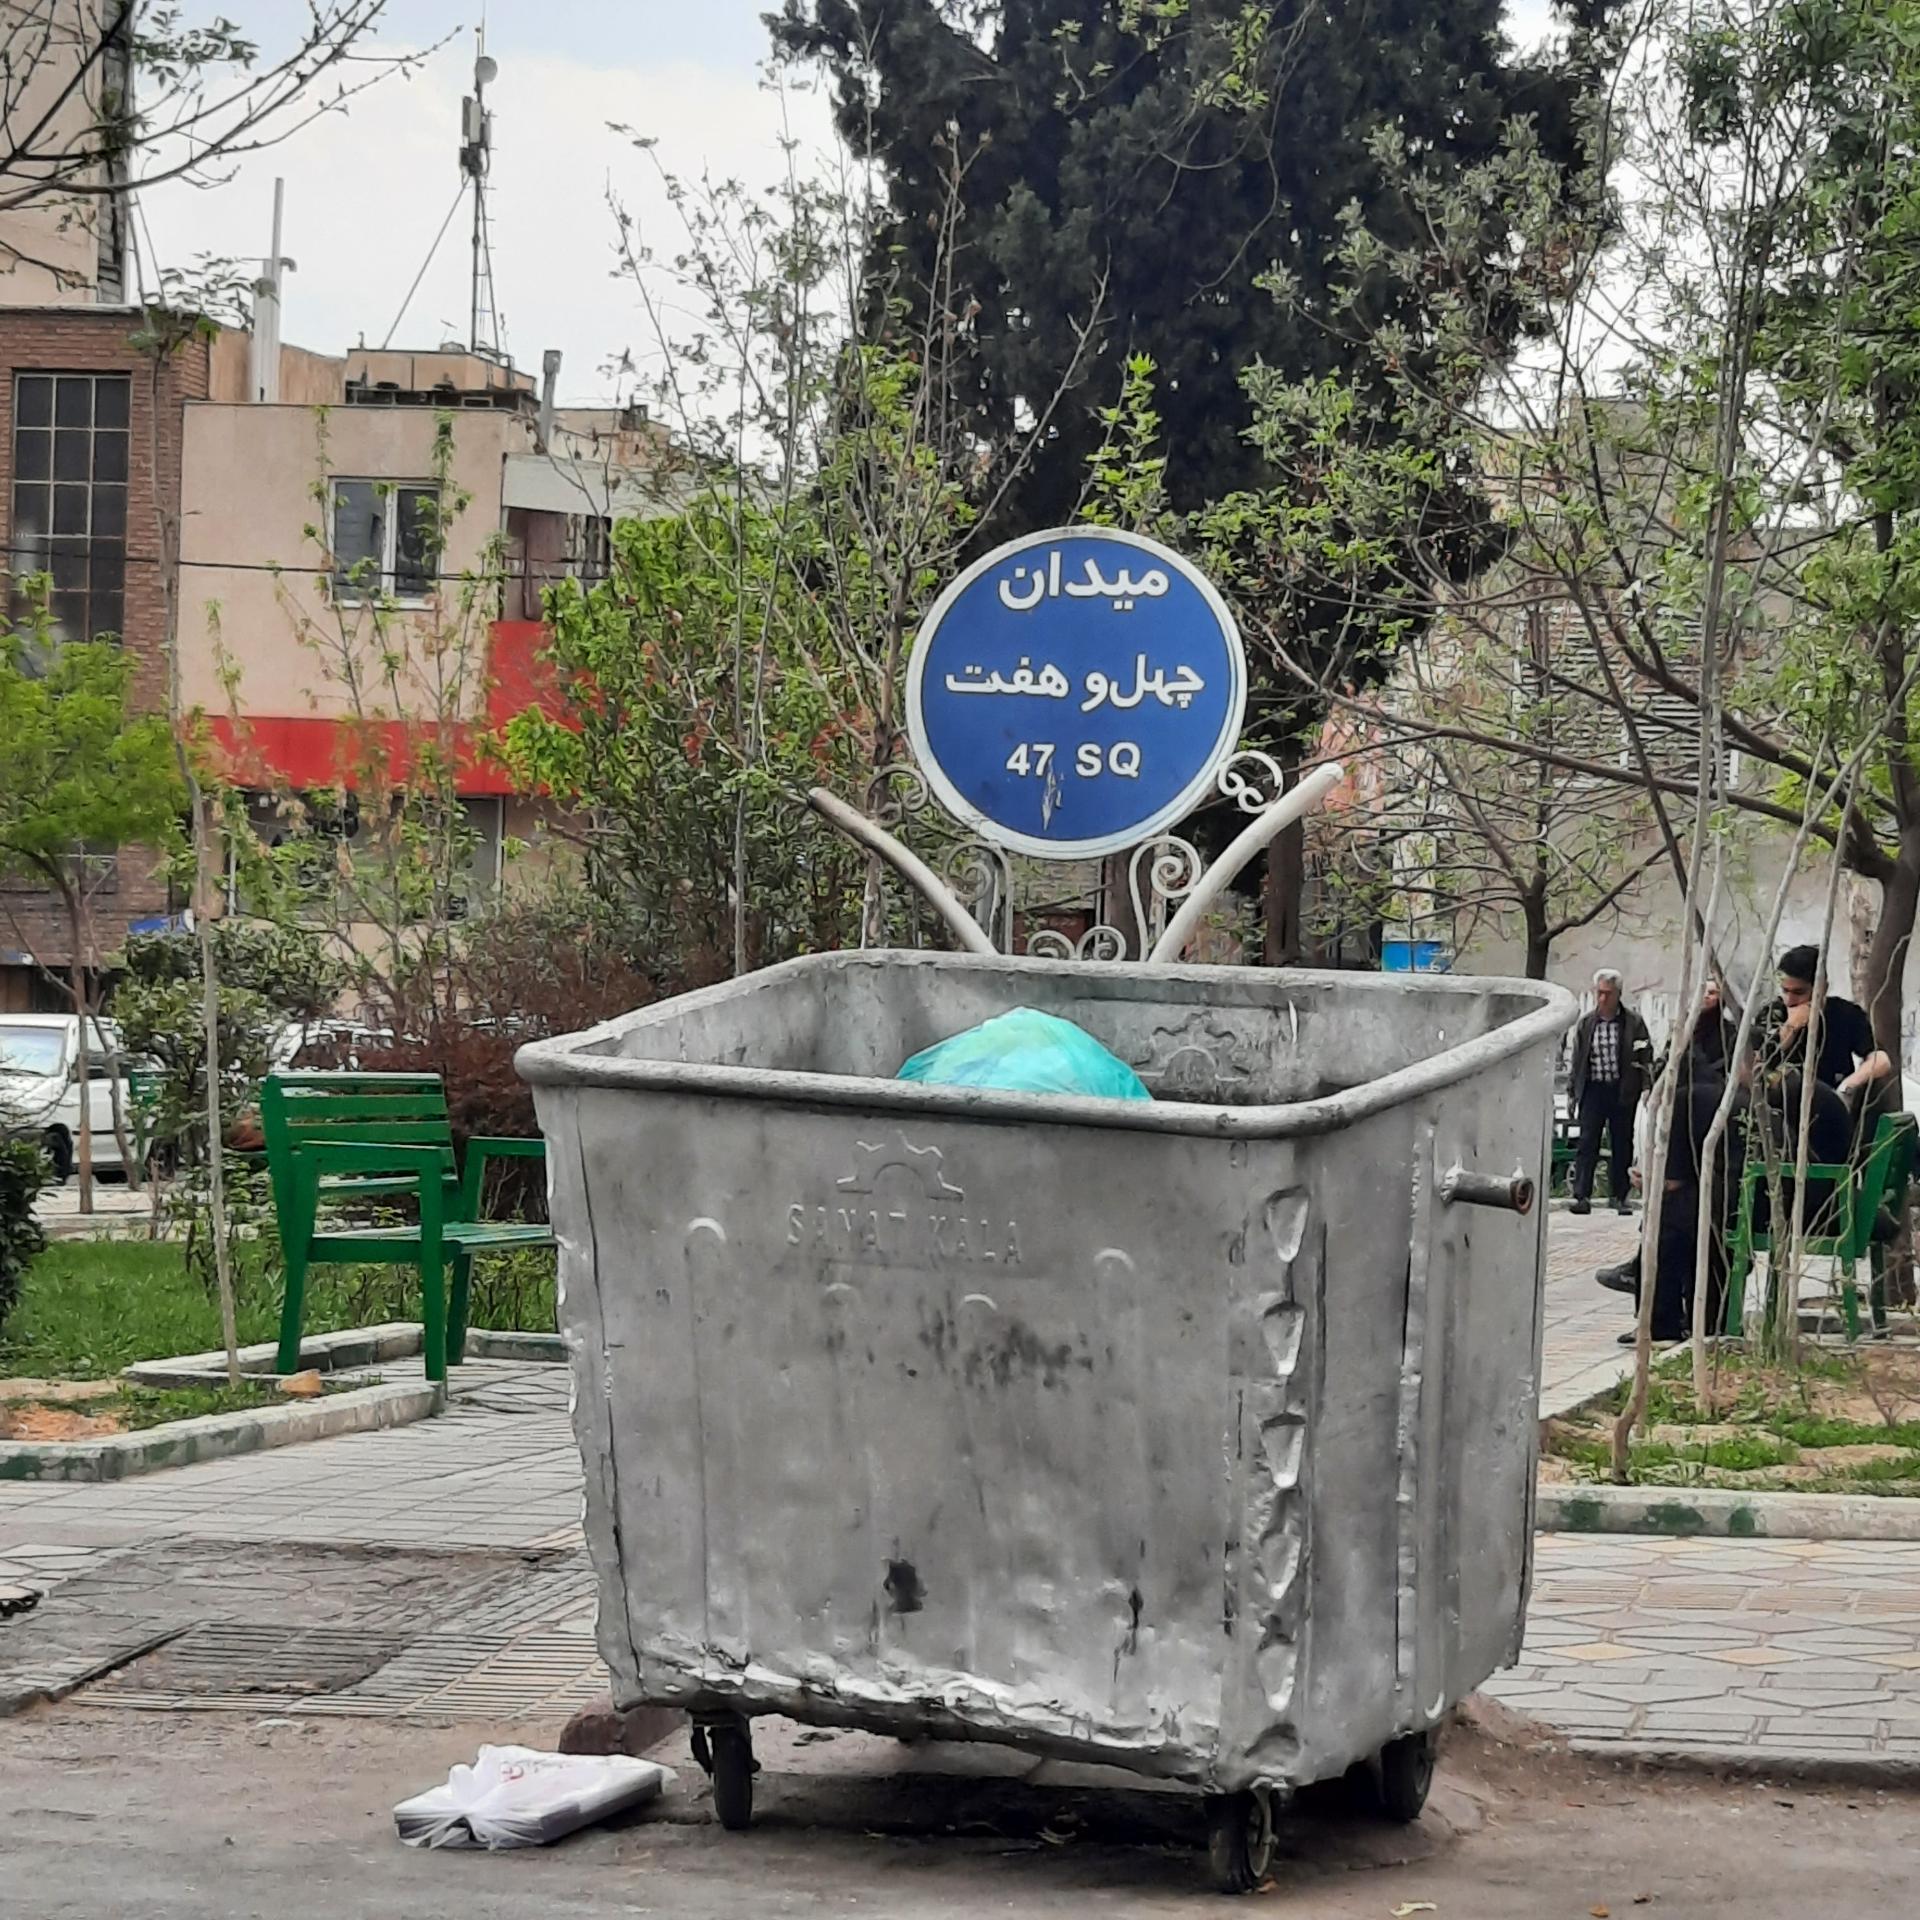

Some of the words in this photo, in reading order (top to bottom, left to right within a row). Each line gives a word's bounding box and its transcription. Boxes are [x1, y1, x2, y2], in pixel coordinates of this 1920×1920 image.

[998, 551, 1170, 611] میدان
[944, 656, 1070, 699] هفت
[1005, 742, 1056, 777] 47
[1074, 741, 1142, 779] SQ
